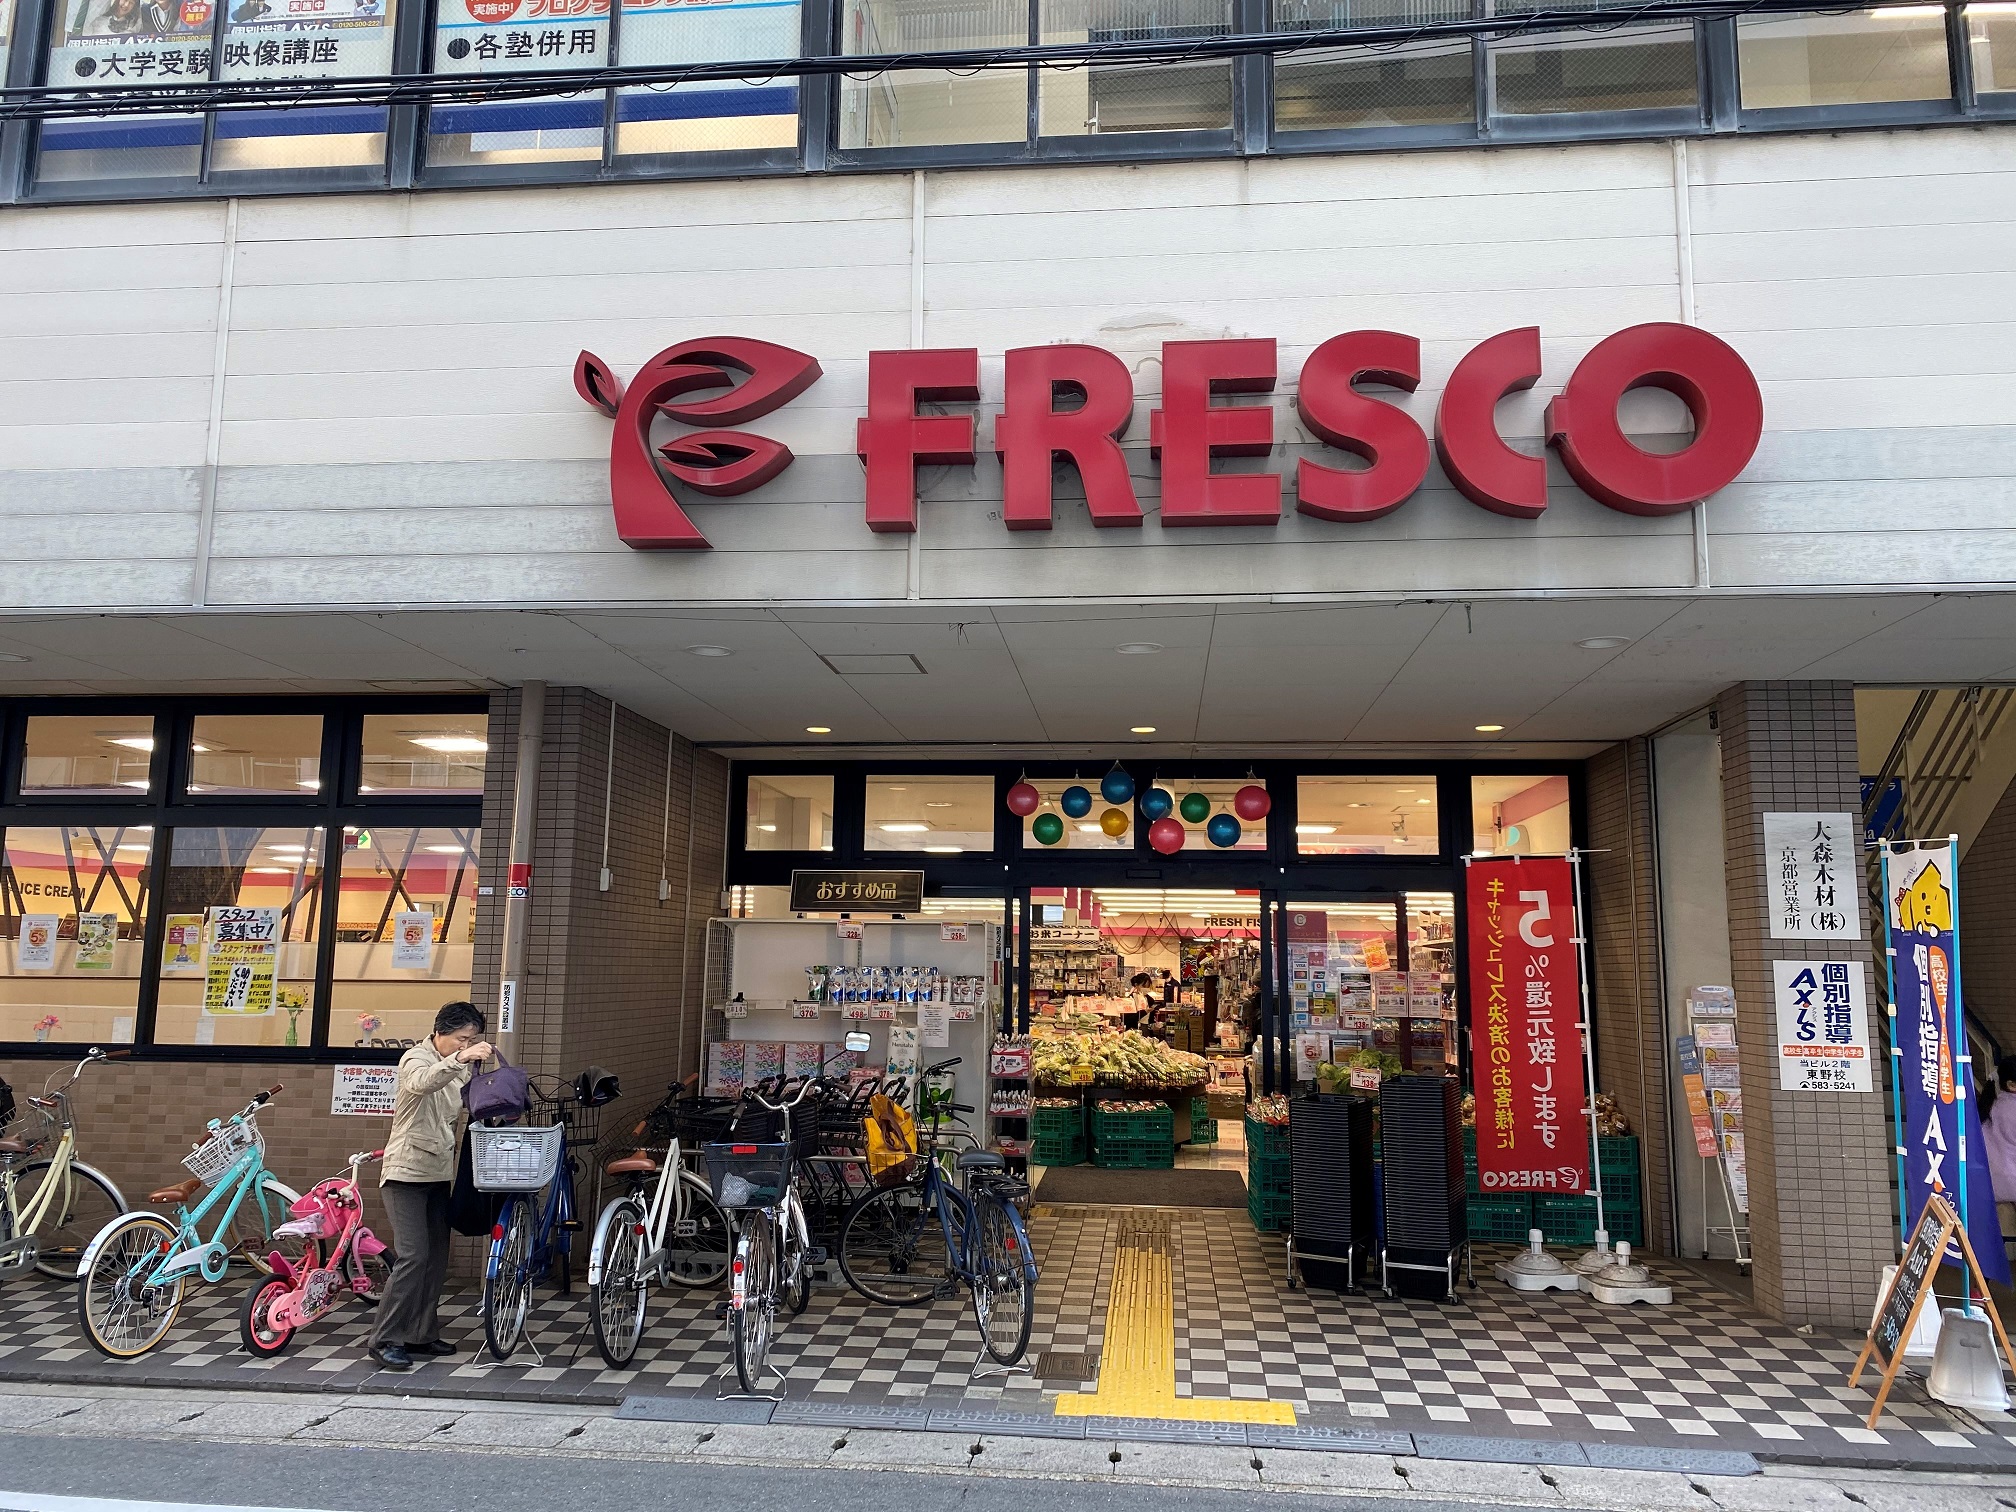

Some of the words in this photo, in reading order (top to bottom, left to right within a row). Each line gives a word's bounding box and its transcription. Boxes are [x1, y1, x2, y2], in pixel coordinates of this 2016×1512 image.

[474, 28, 597, 60] 各塾併用
[99, 48, 211, 78] 大学受験
[223, 37, 339, 67] 映像講座
[857, 321, 1764, 535] FRESCO
[20, 882, 41, 895] ICE
[816, 881, 897, 900] おすすめ品
[1780, 846, 1801, 931] 京都営業所
[218, 908, 256, 921] スタッフ
[1203, 917, 1242, 927] FRESH
[1030, 929, 1095, 939] お米コーナー
[223, 966, 241, 1008] ください
[1821, 962, 1853, 1044] 個別指導
[1824, 1047, 1844, 1056] 中学生
[1844, 1047, 1864, 1057] 小学生
[1806, 1069, 1846, 1080] 東野校
[1811, 1081, 1856, 1090] 583-5241
